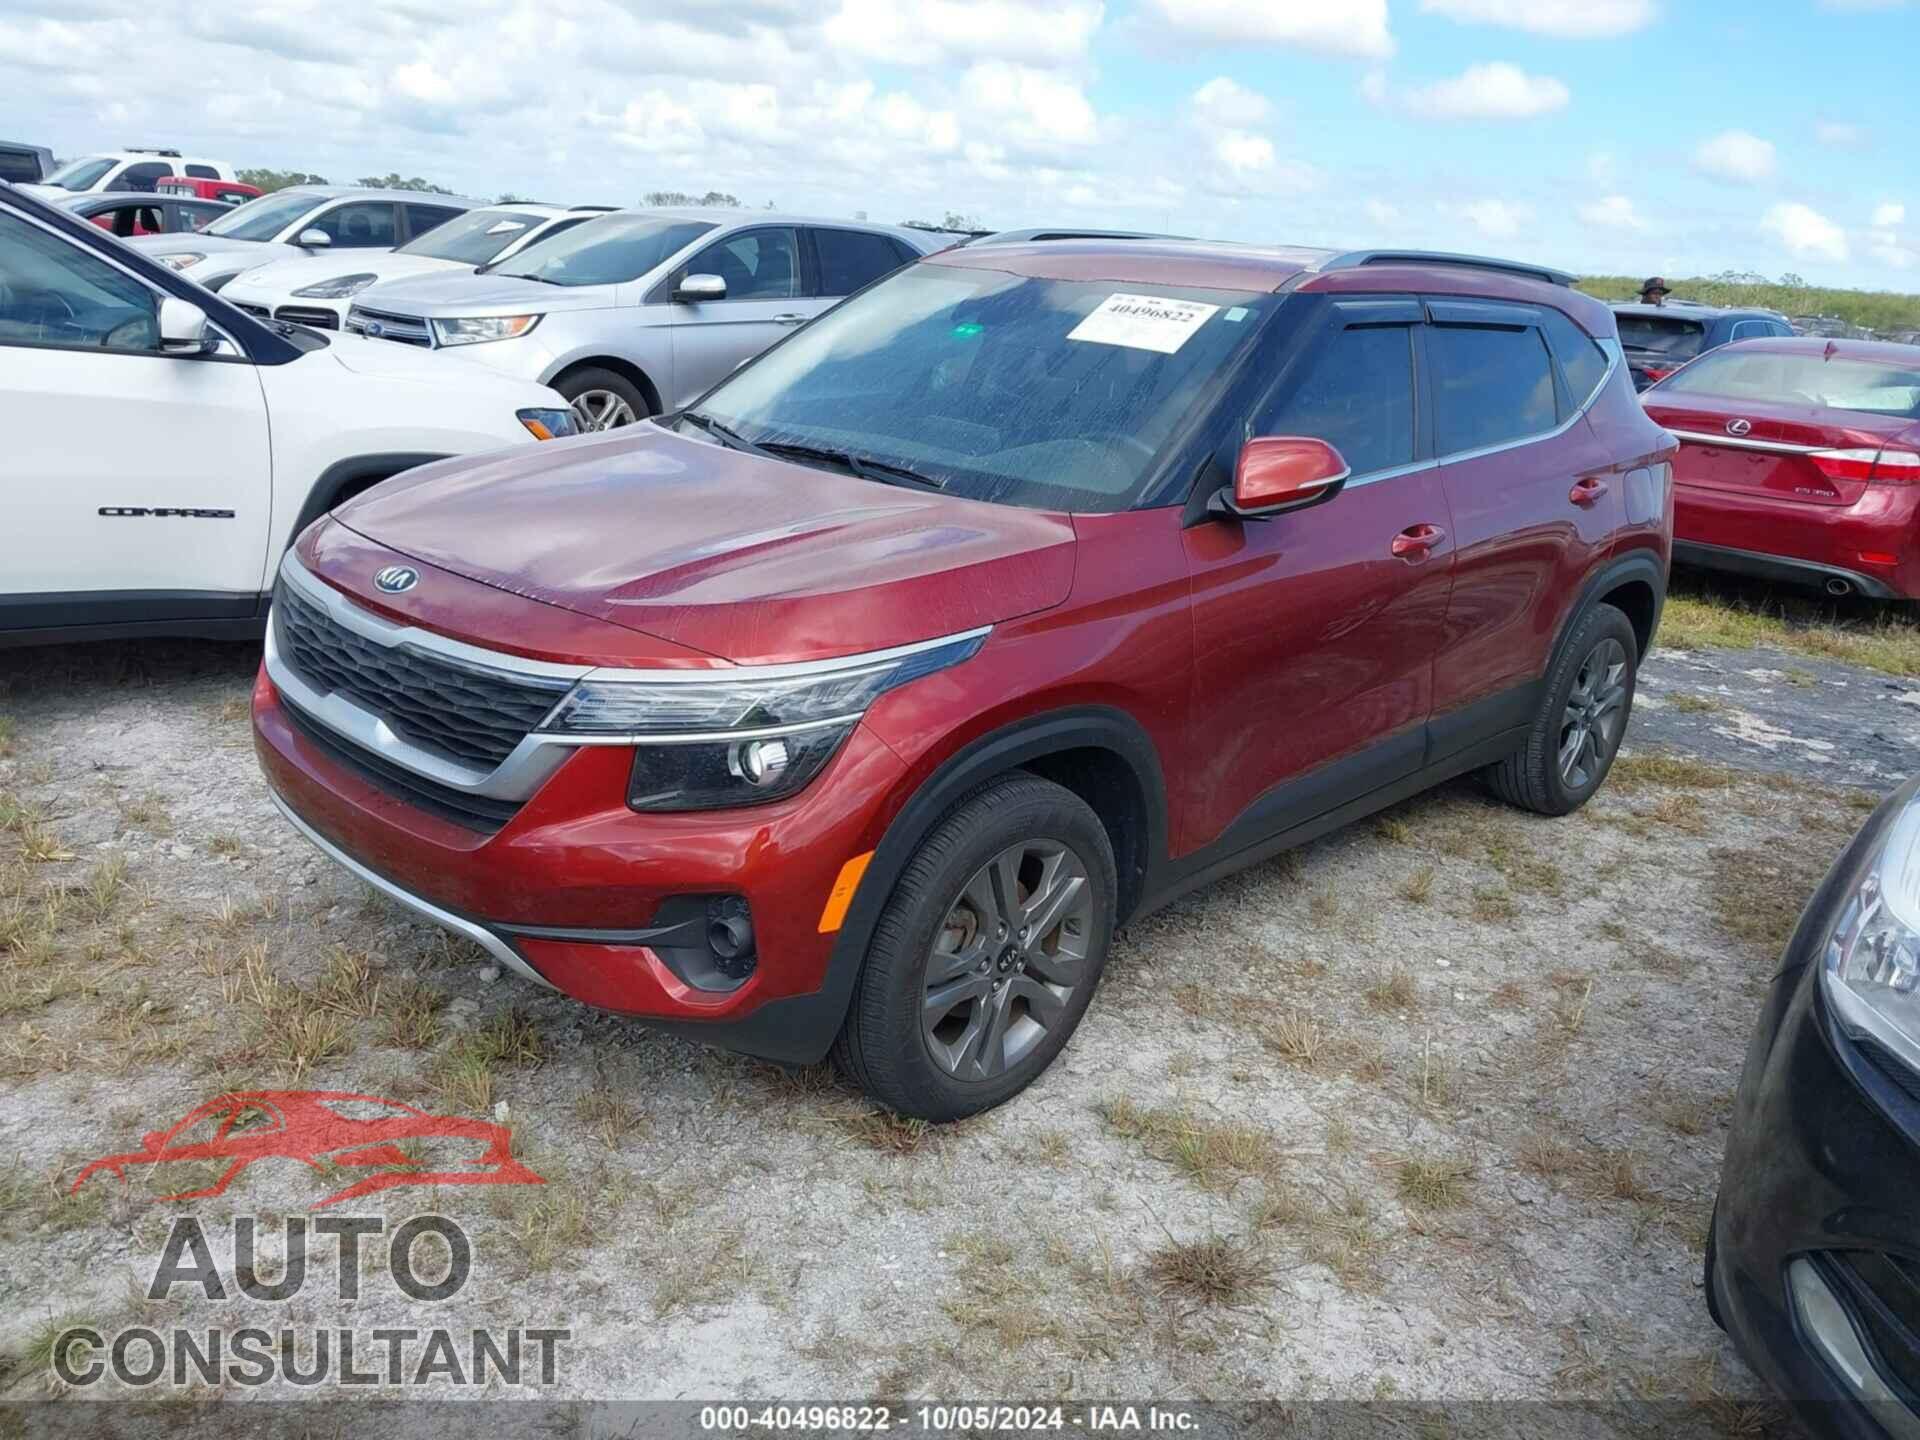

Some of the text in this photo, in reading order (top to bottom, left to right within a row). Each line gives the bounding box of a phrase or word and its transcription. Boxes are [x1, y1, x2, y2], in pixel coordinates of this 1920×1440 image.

[1109, 304, 1194, 322] 40496822
[98, 507, 235, 519] COMPASS
[381, 568, 411, 589] KIA
[999, 949, 1018, 970] KIA
